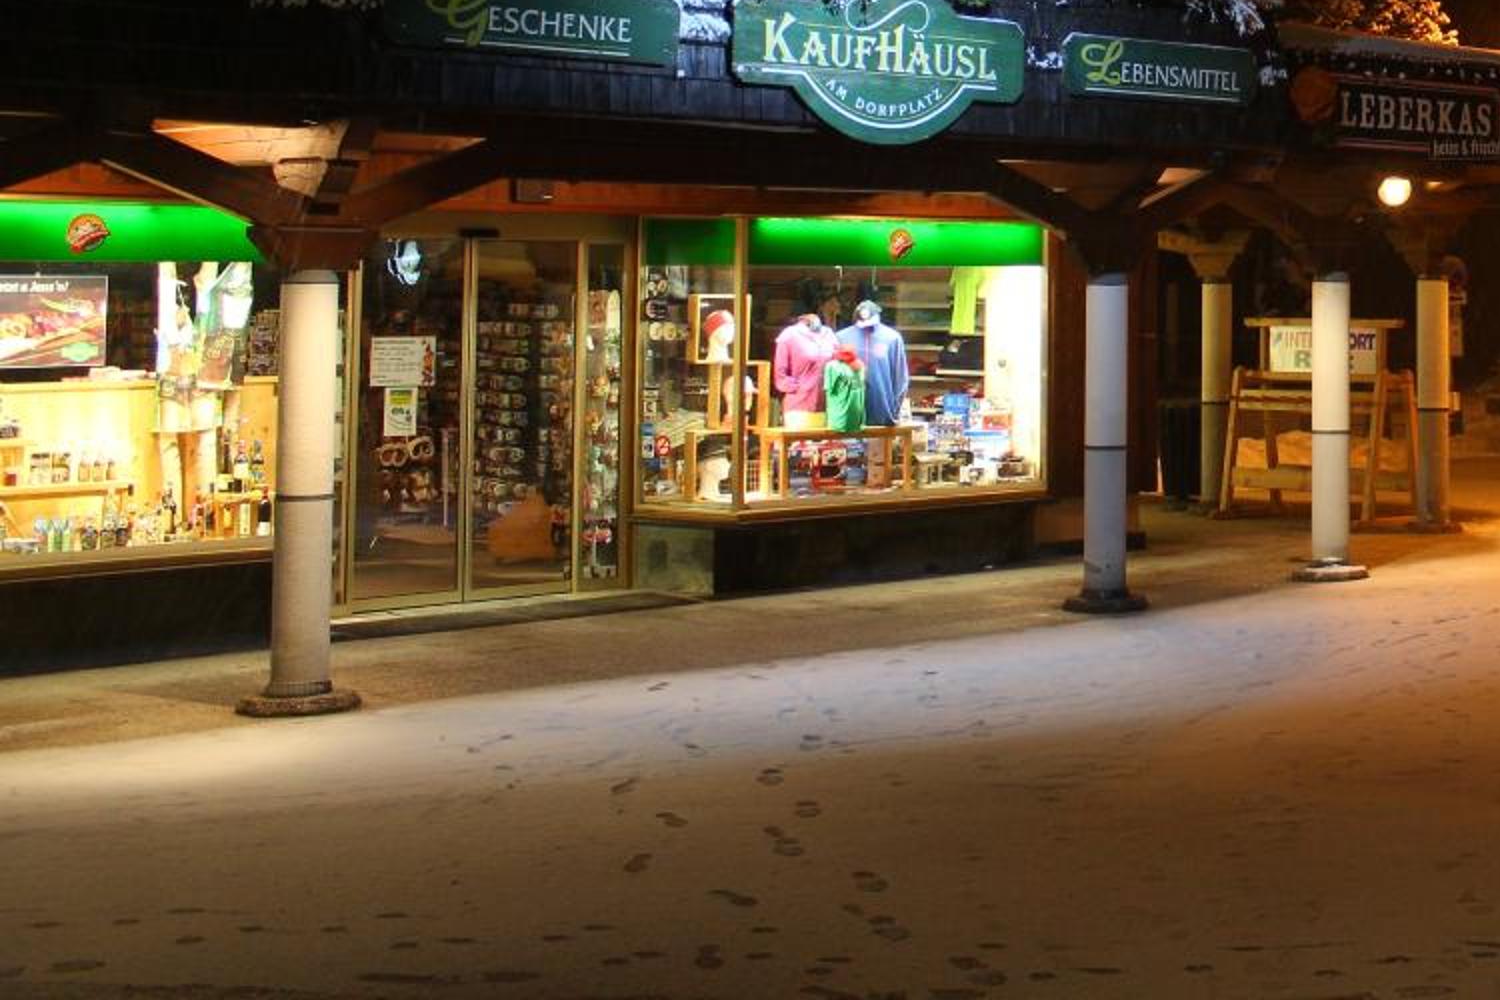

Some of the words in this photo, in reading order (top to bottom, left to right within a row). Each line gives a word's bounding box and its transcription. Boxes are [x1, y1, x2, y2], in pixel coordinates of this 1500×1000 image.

[763, 11, 997, 81] KAUFHÄUSL
[1081, 40, 1241, 92] LEBENSMITTEL
[825, 78, 847, 101] AM
[854, 86, 944, 117] DORFPLATZ
[1339, 89, 1493, 137] LEBERKAS
